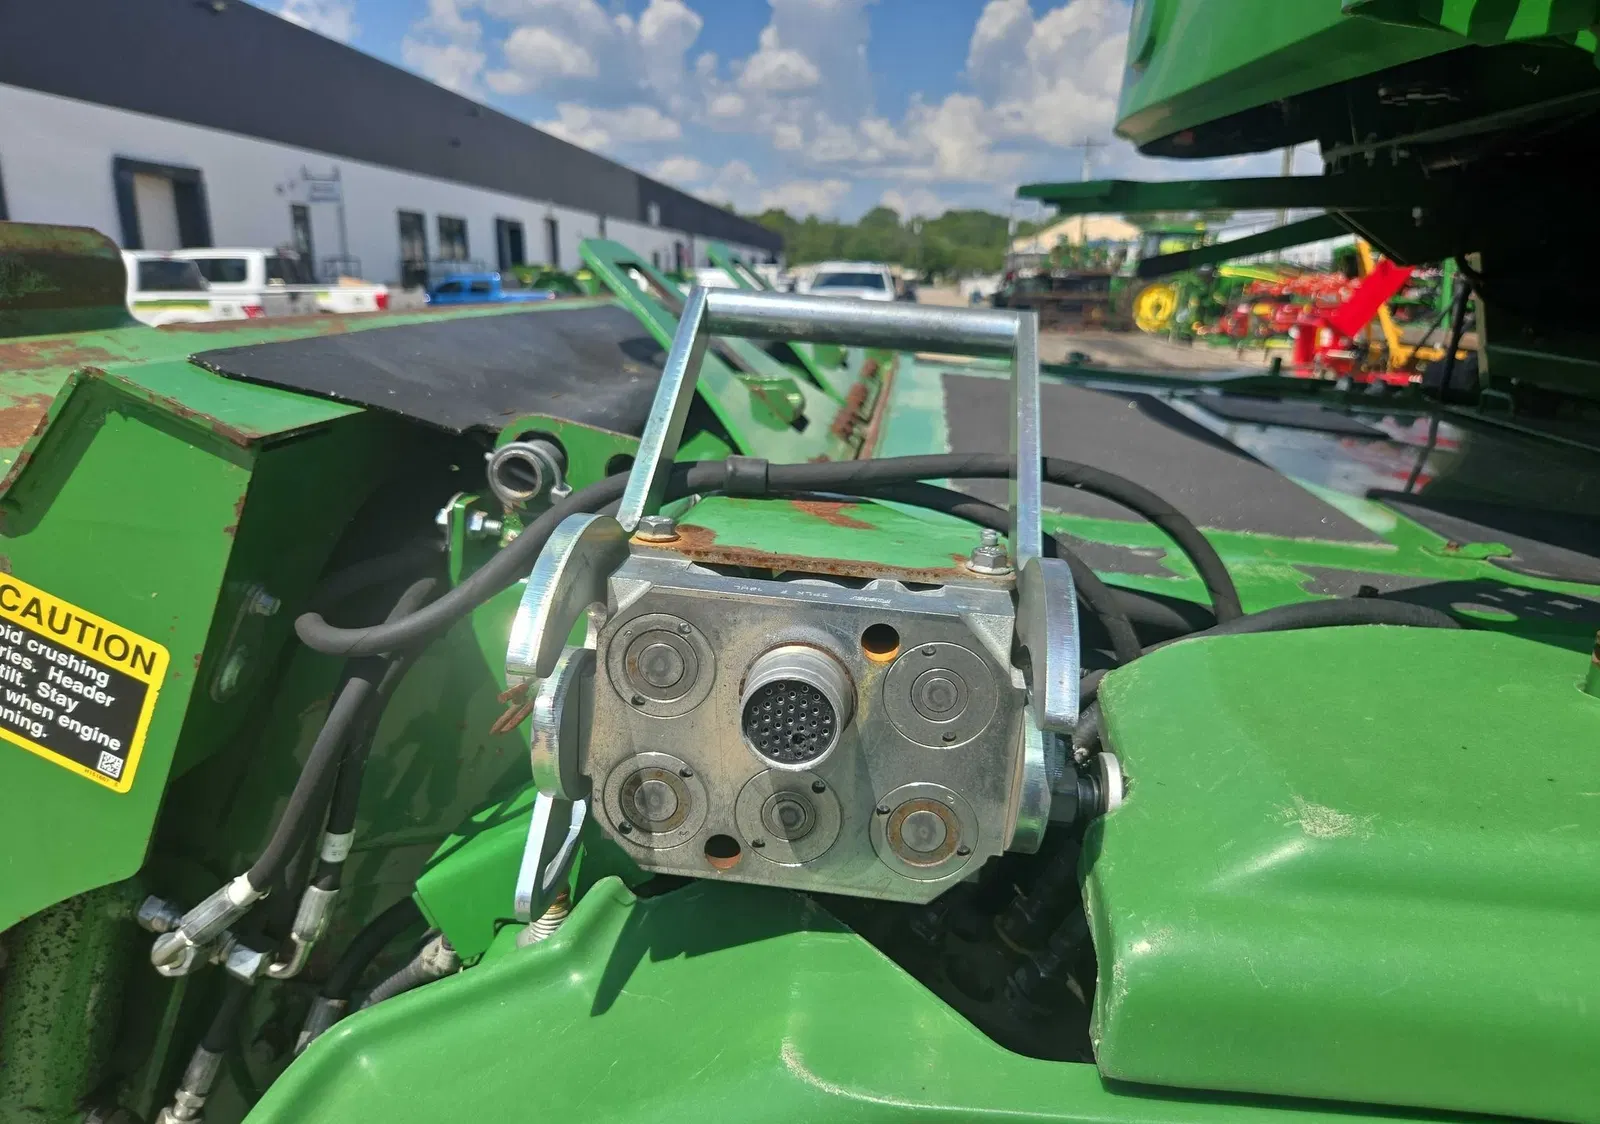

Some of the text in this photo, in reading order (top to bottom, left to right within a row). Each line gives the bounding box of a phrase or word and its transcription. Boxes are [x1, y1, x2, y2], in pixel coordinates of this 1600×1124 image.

[0, 584, 157, 676] CAUTION
[0, 663, 80, 713] tilt. Stay
[27, 639, 110, 688] crushing
[48, 666, 116, 707] Header
[6, 689, 121, 751] when engine
